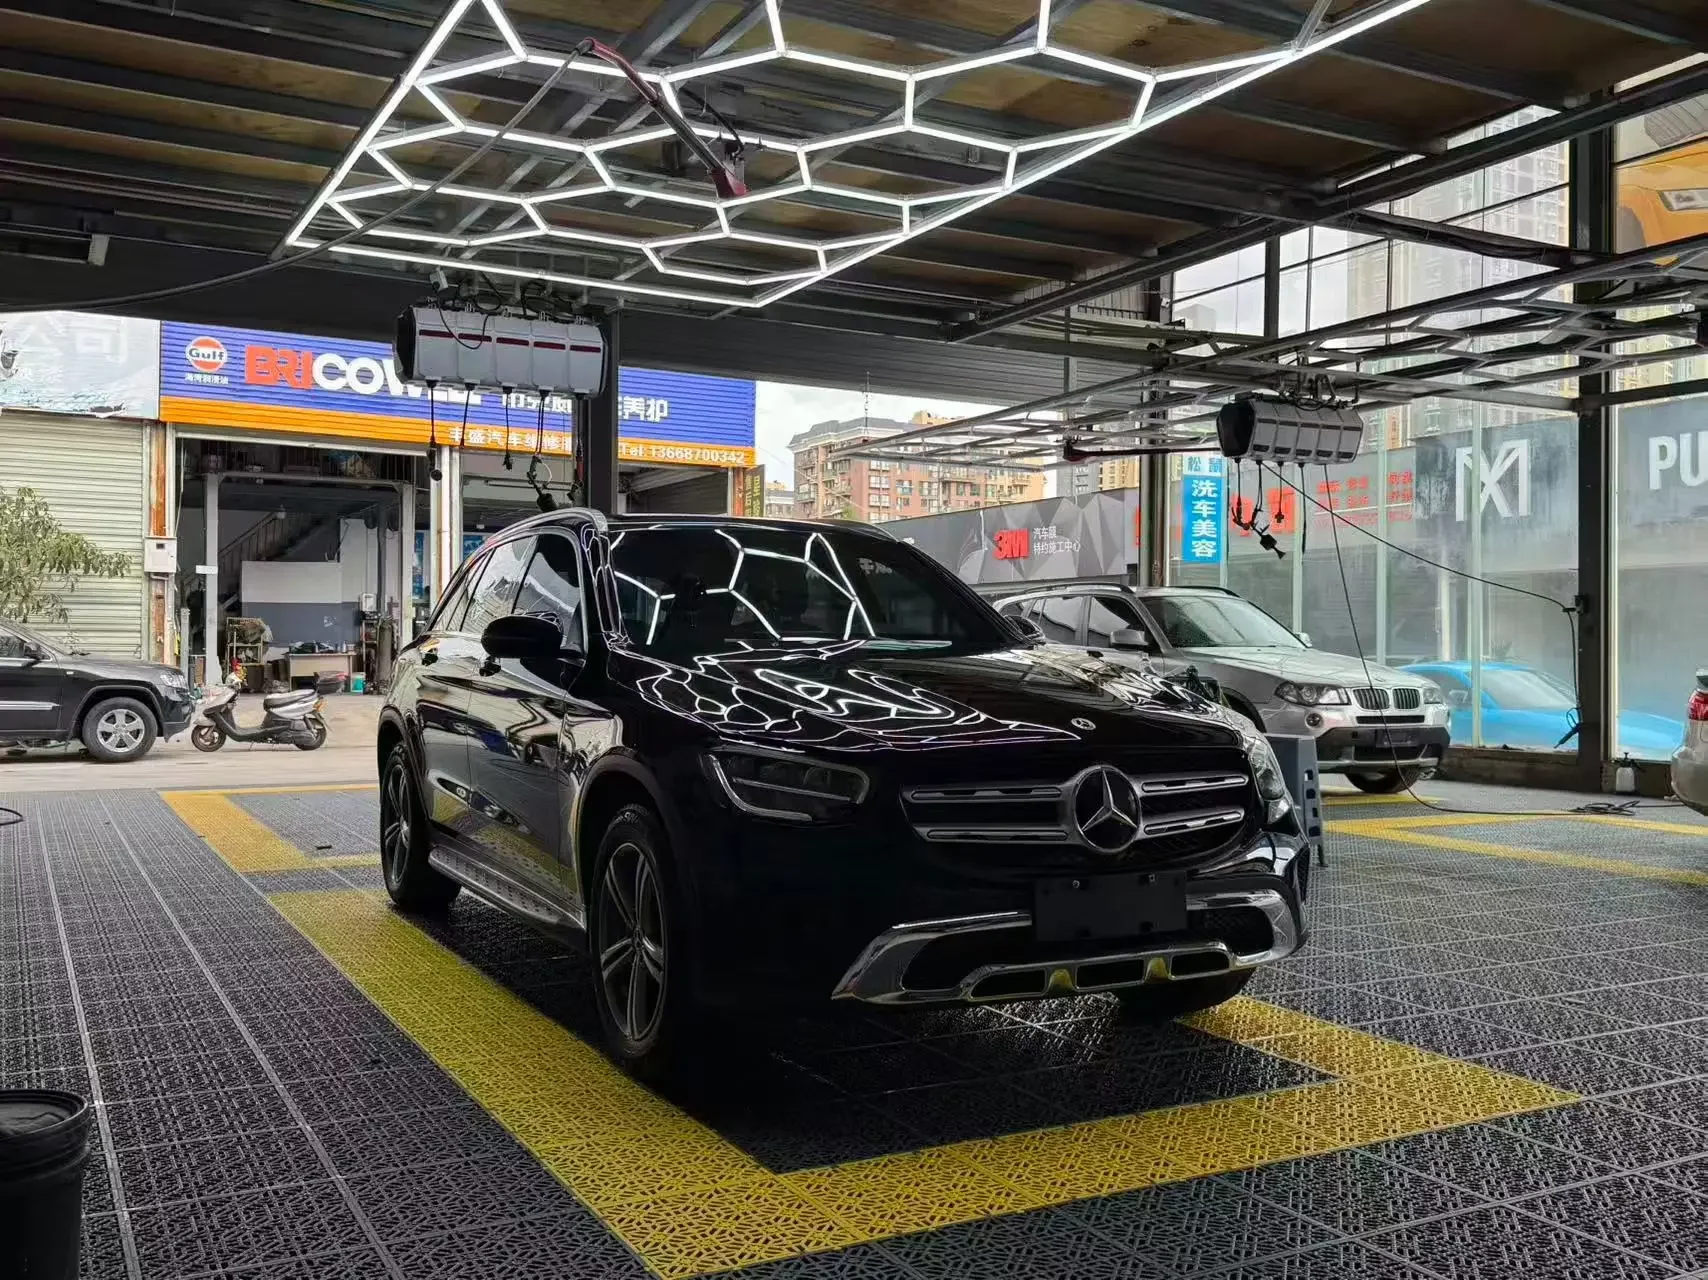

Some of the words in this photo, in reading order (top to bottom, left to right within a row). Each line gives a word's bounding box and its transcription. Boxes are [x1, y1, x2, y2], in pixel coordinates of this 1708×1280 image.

[188, 347, 225, 361] Gulf
[651, 446, 745, 464] 13668700342
[1191, 479, 1218, 558] 洗车美容
[993, 527, 1029, 560] 3M
